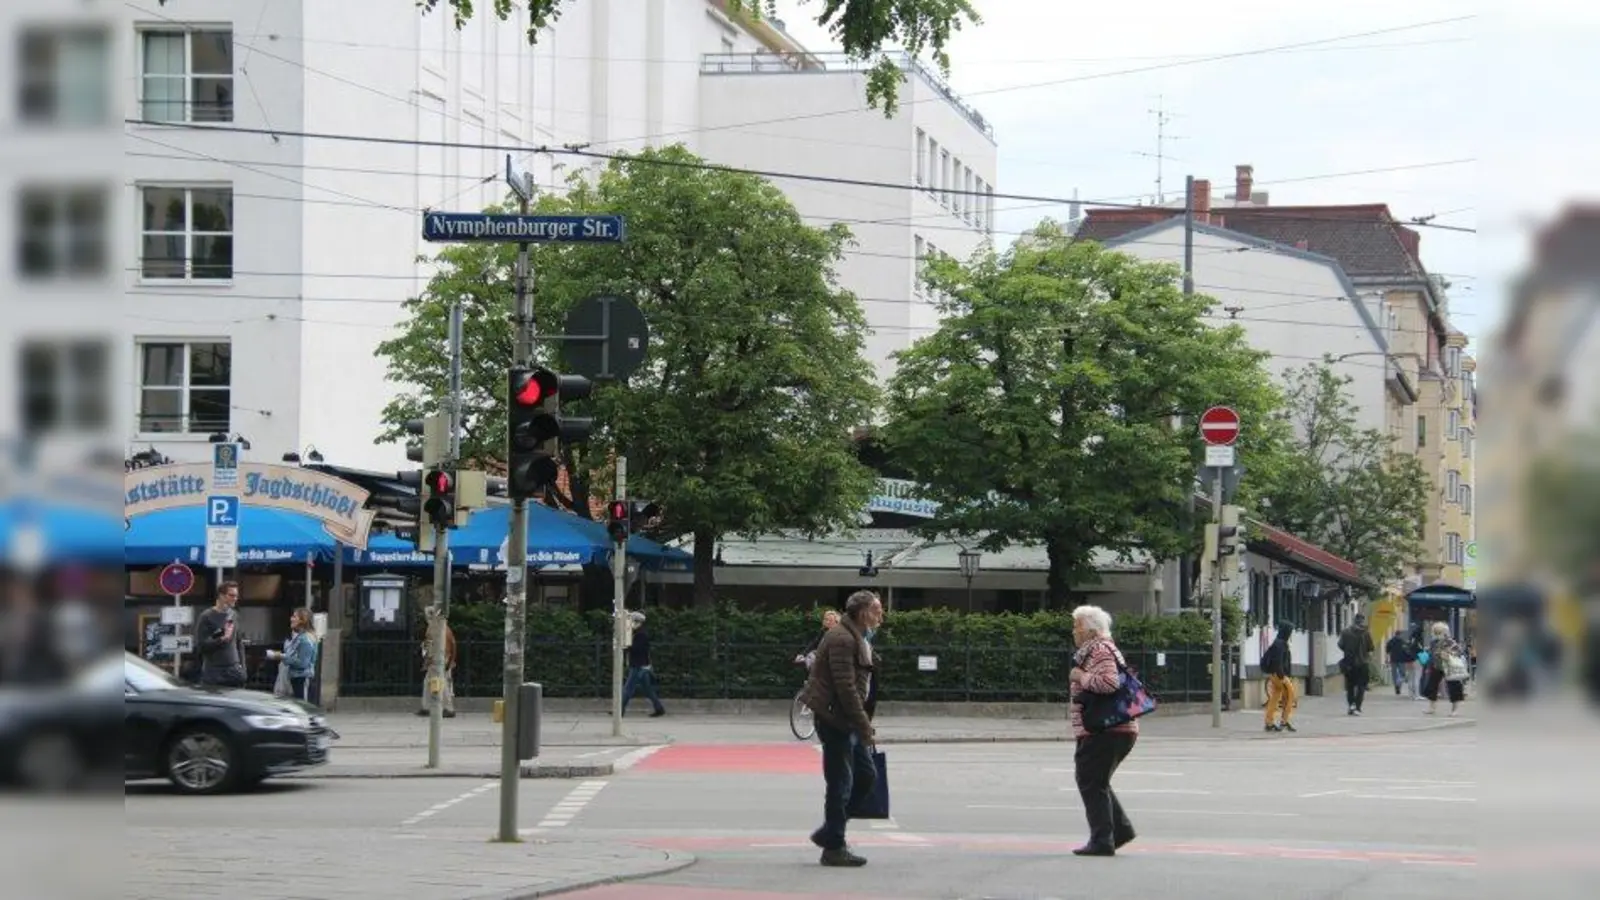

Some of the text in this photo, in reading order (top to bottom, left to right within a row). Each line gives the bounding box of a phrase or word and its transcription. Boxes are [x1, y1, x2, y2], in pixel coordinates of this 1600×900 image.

[432, 215, 613, 239] Nymphenburger Str.
[125, 474, 204, 505] ststätte
[244, 472, 358, 519] Jagdschlößl
[212, 499, 229, 523] P
